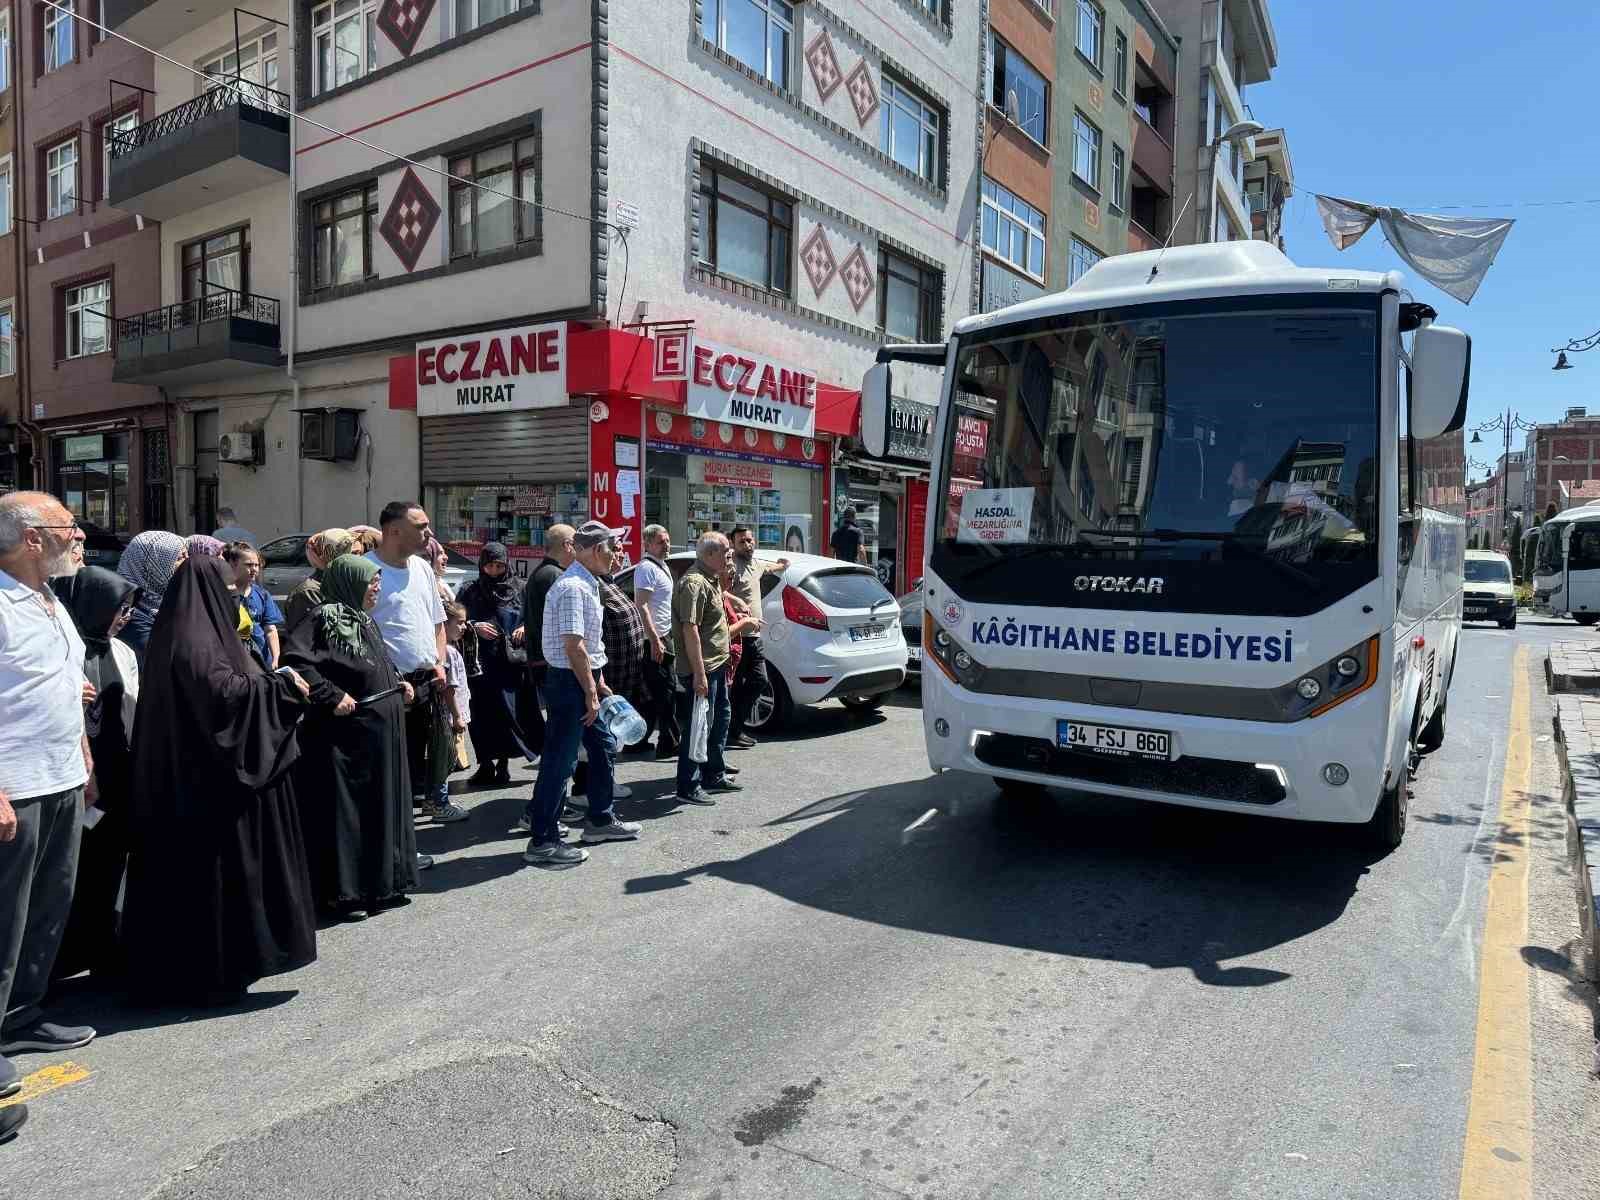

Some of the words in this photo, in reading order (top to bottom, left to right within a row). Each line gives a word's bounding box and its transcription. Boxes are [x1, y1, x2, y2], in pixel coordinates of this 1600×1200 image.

[418, 330, 560, 385] ECZANE
[662, 338, 680, 370] E
[693, 345, 816, 409] ECZANE
[456, 383, 515, 406] MURAT
[730, 400, 782, 425] MURAT
[975, 507, 1016, 518] HASDAL
[1073, 575, 1164, 593] OTOKAR
[971, 616, 1116, 653] KÂĞITHANE
[1123, 626, 1293, 663] BELEDİYESİ
[1068, 725, 1087, 744] 34
[1095, 728, 1126, 748] FSJ
[1136, 733, 1167, 753] 860
